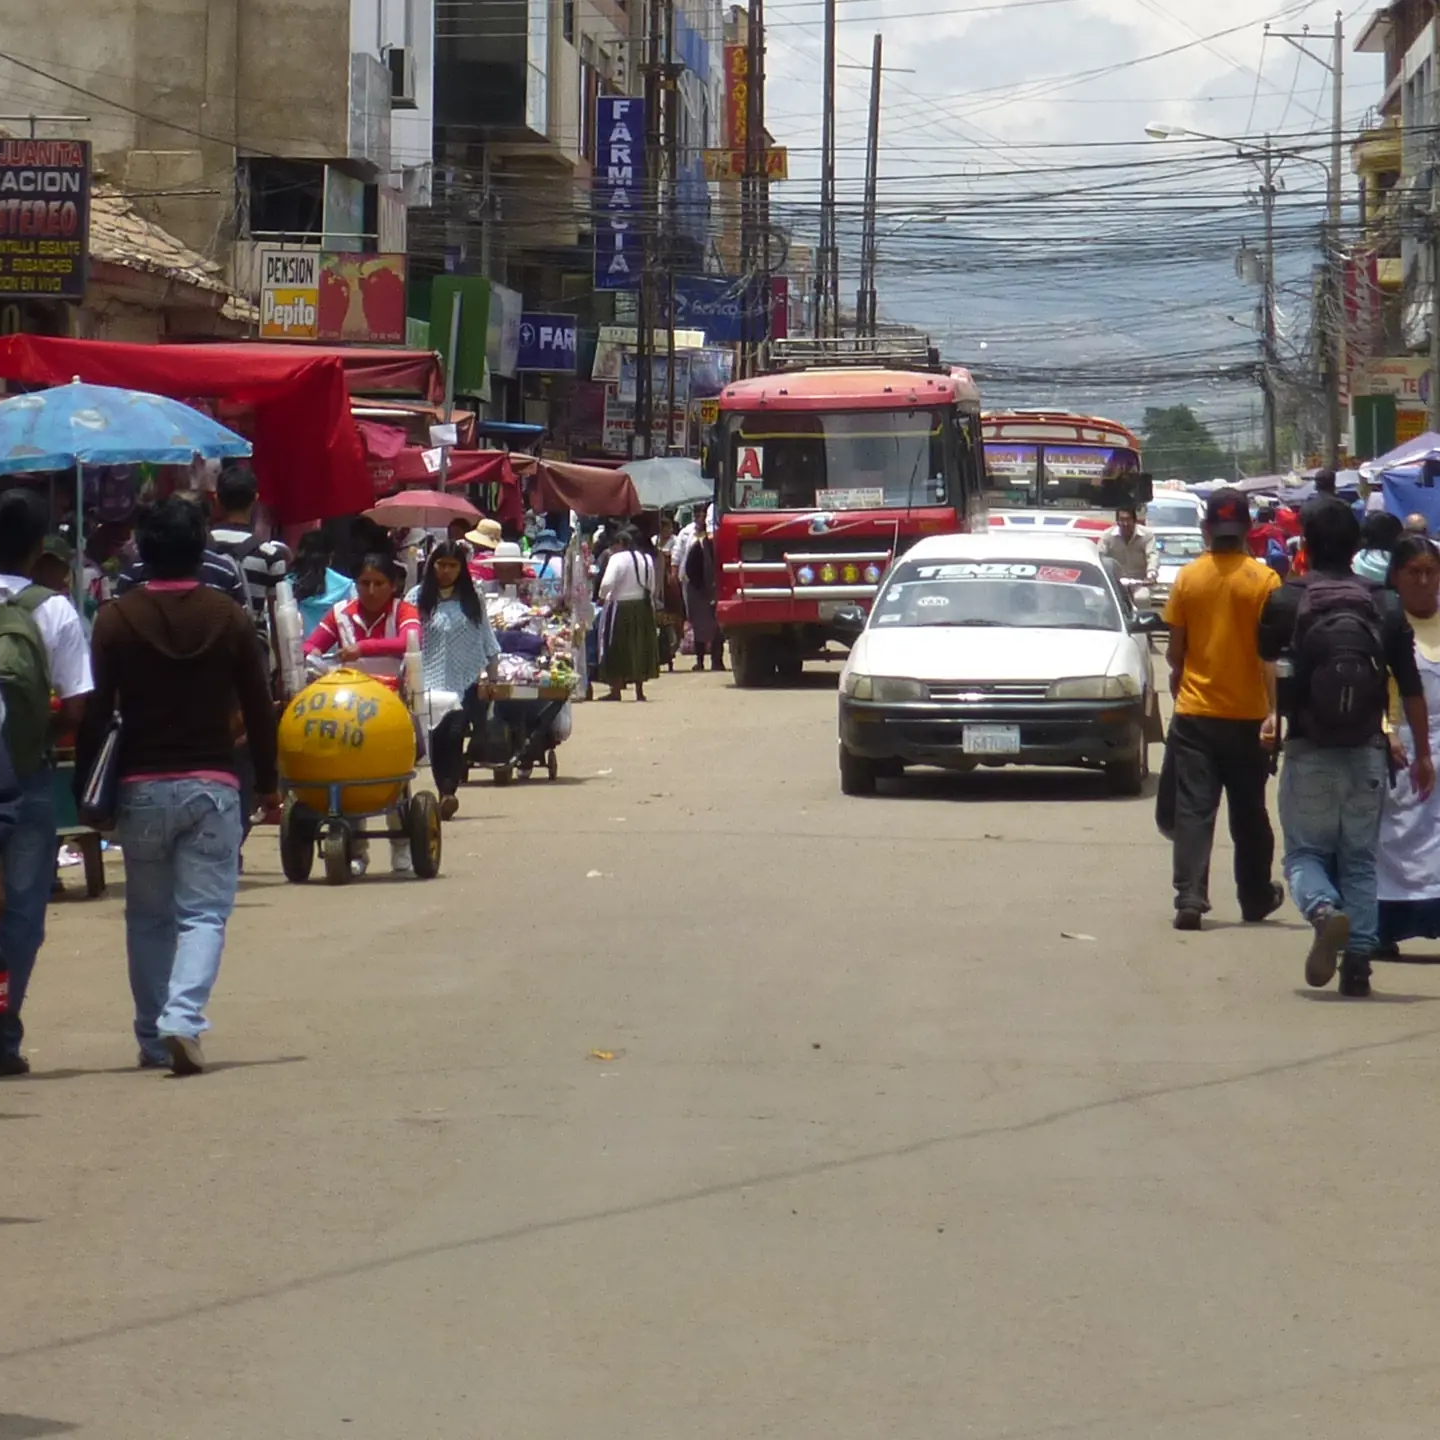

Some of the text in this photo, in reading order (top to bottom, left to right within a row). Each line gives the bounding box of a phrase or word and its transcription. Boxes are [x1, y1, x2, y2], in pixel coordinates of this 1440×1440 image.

[606, 100, 633, 274] FARMACIA
[266, 256, 314, 284] PENSION
[263, 289, 315, 332] Pepito
[736, 447, 762, 479] A
[916, 563, 1037, 579] TENZO
